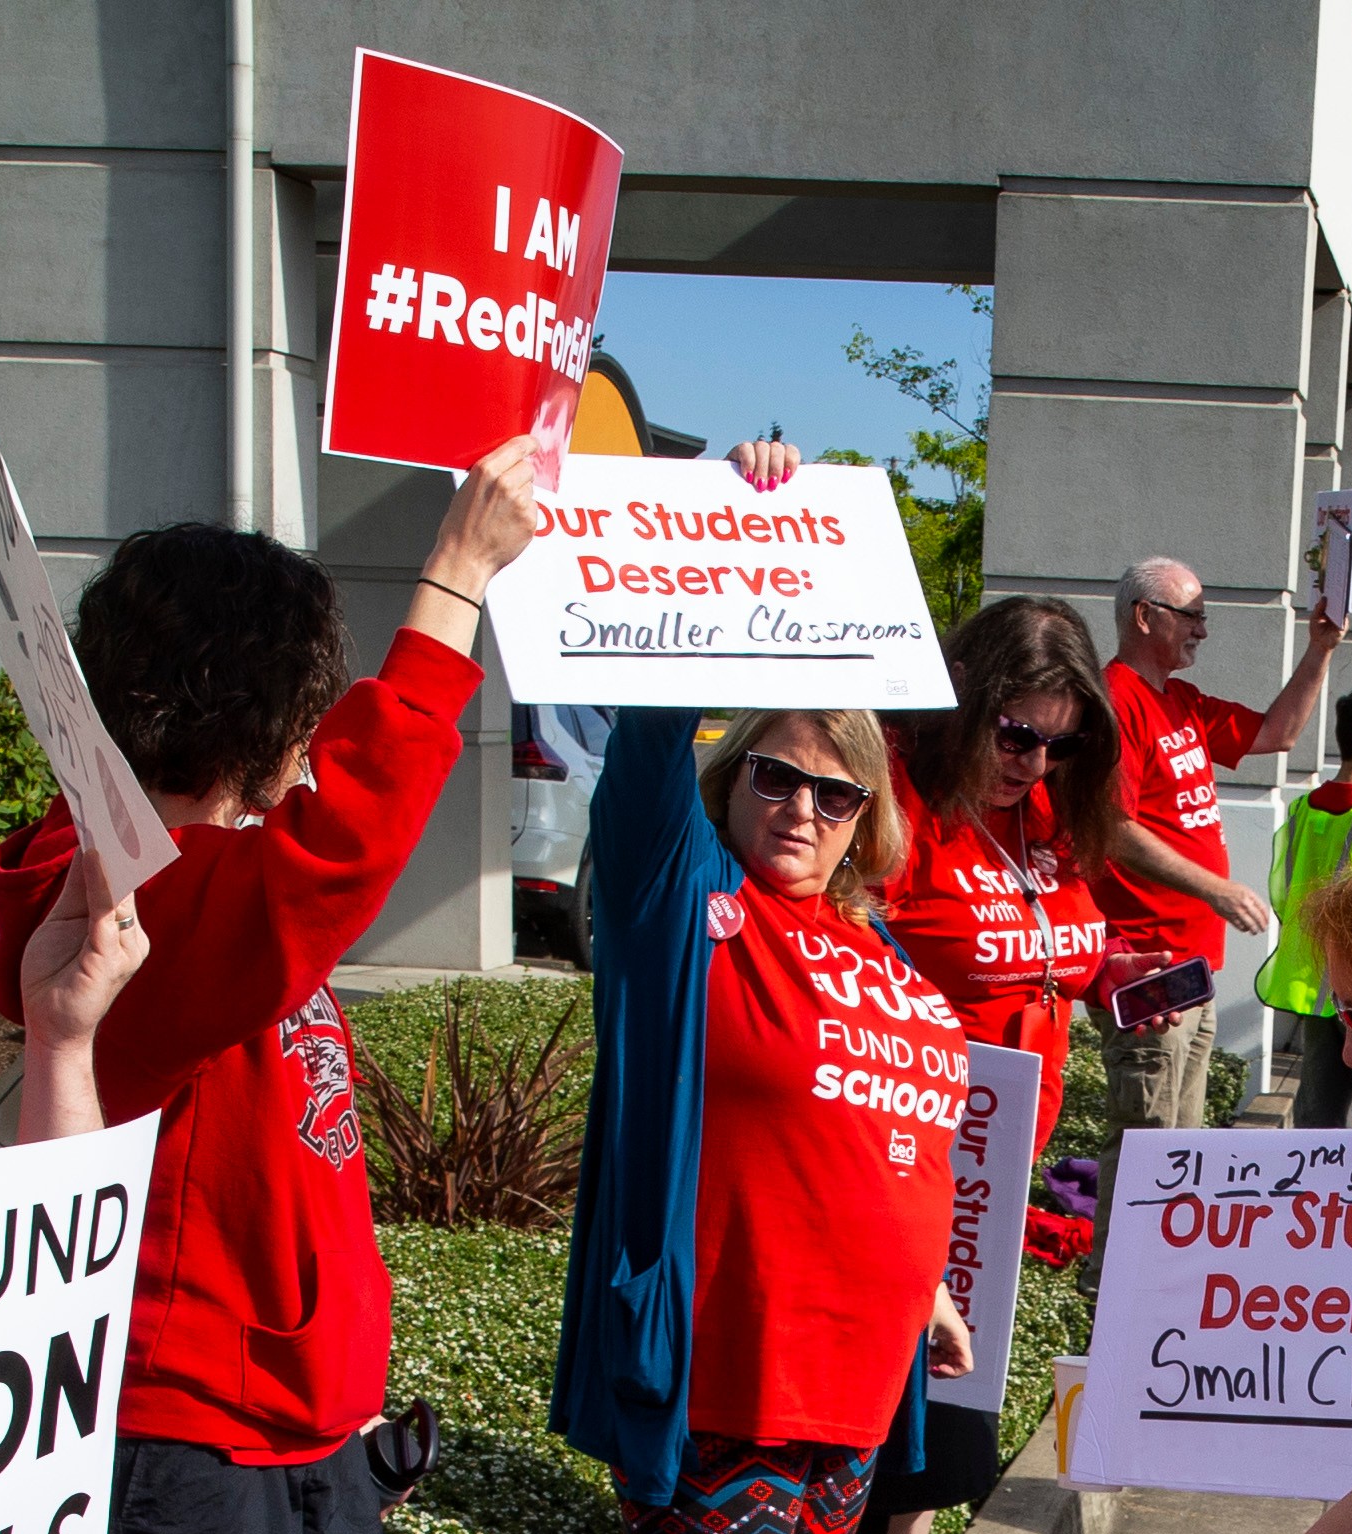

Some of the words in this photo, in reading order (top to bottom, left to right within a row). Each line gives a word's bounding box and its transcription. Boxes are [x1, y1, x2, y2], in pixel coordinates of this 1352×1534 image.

[494, 184, 511, 253] I
[523, 197, 581, 278] AM
[366, 263, 592, 384] #RedForEd
[627, 501, 846, 546] Students
[576, 555, 814, 598] Deserve:
[559, 602, 724, 652] Smaller
[747, 604, 923, 644] Classrooms
[954, 868, 974, 894] I
[971, 900, 1024, 923] with
[818, 1018, 914, 1070] FUND
[921, 1045, 969, 1087] OUR
[811, 1063, 966, 1131] SCHOOLS
[889, 1142, 917, 1161] oea
[956, 1085, 999, 1168] Our
[1155, 1150, 1204, 1190] 31
[1227, 1153, 1261, 1182] in
[1273, 1142, 1345, 1192] 2nd
[1160, 1193, 1274, 1249] Our
[1146, 1327, 1287, 1409] Small
